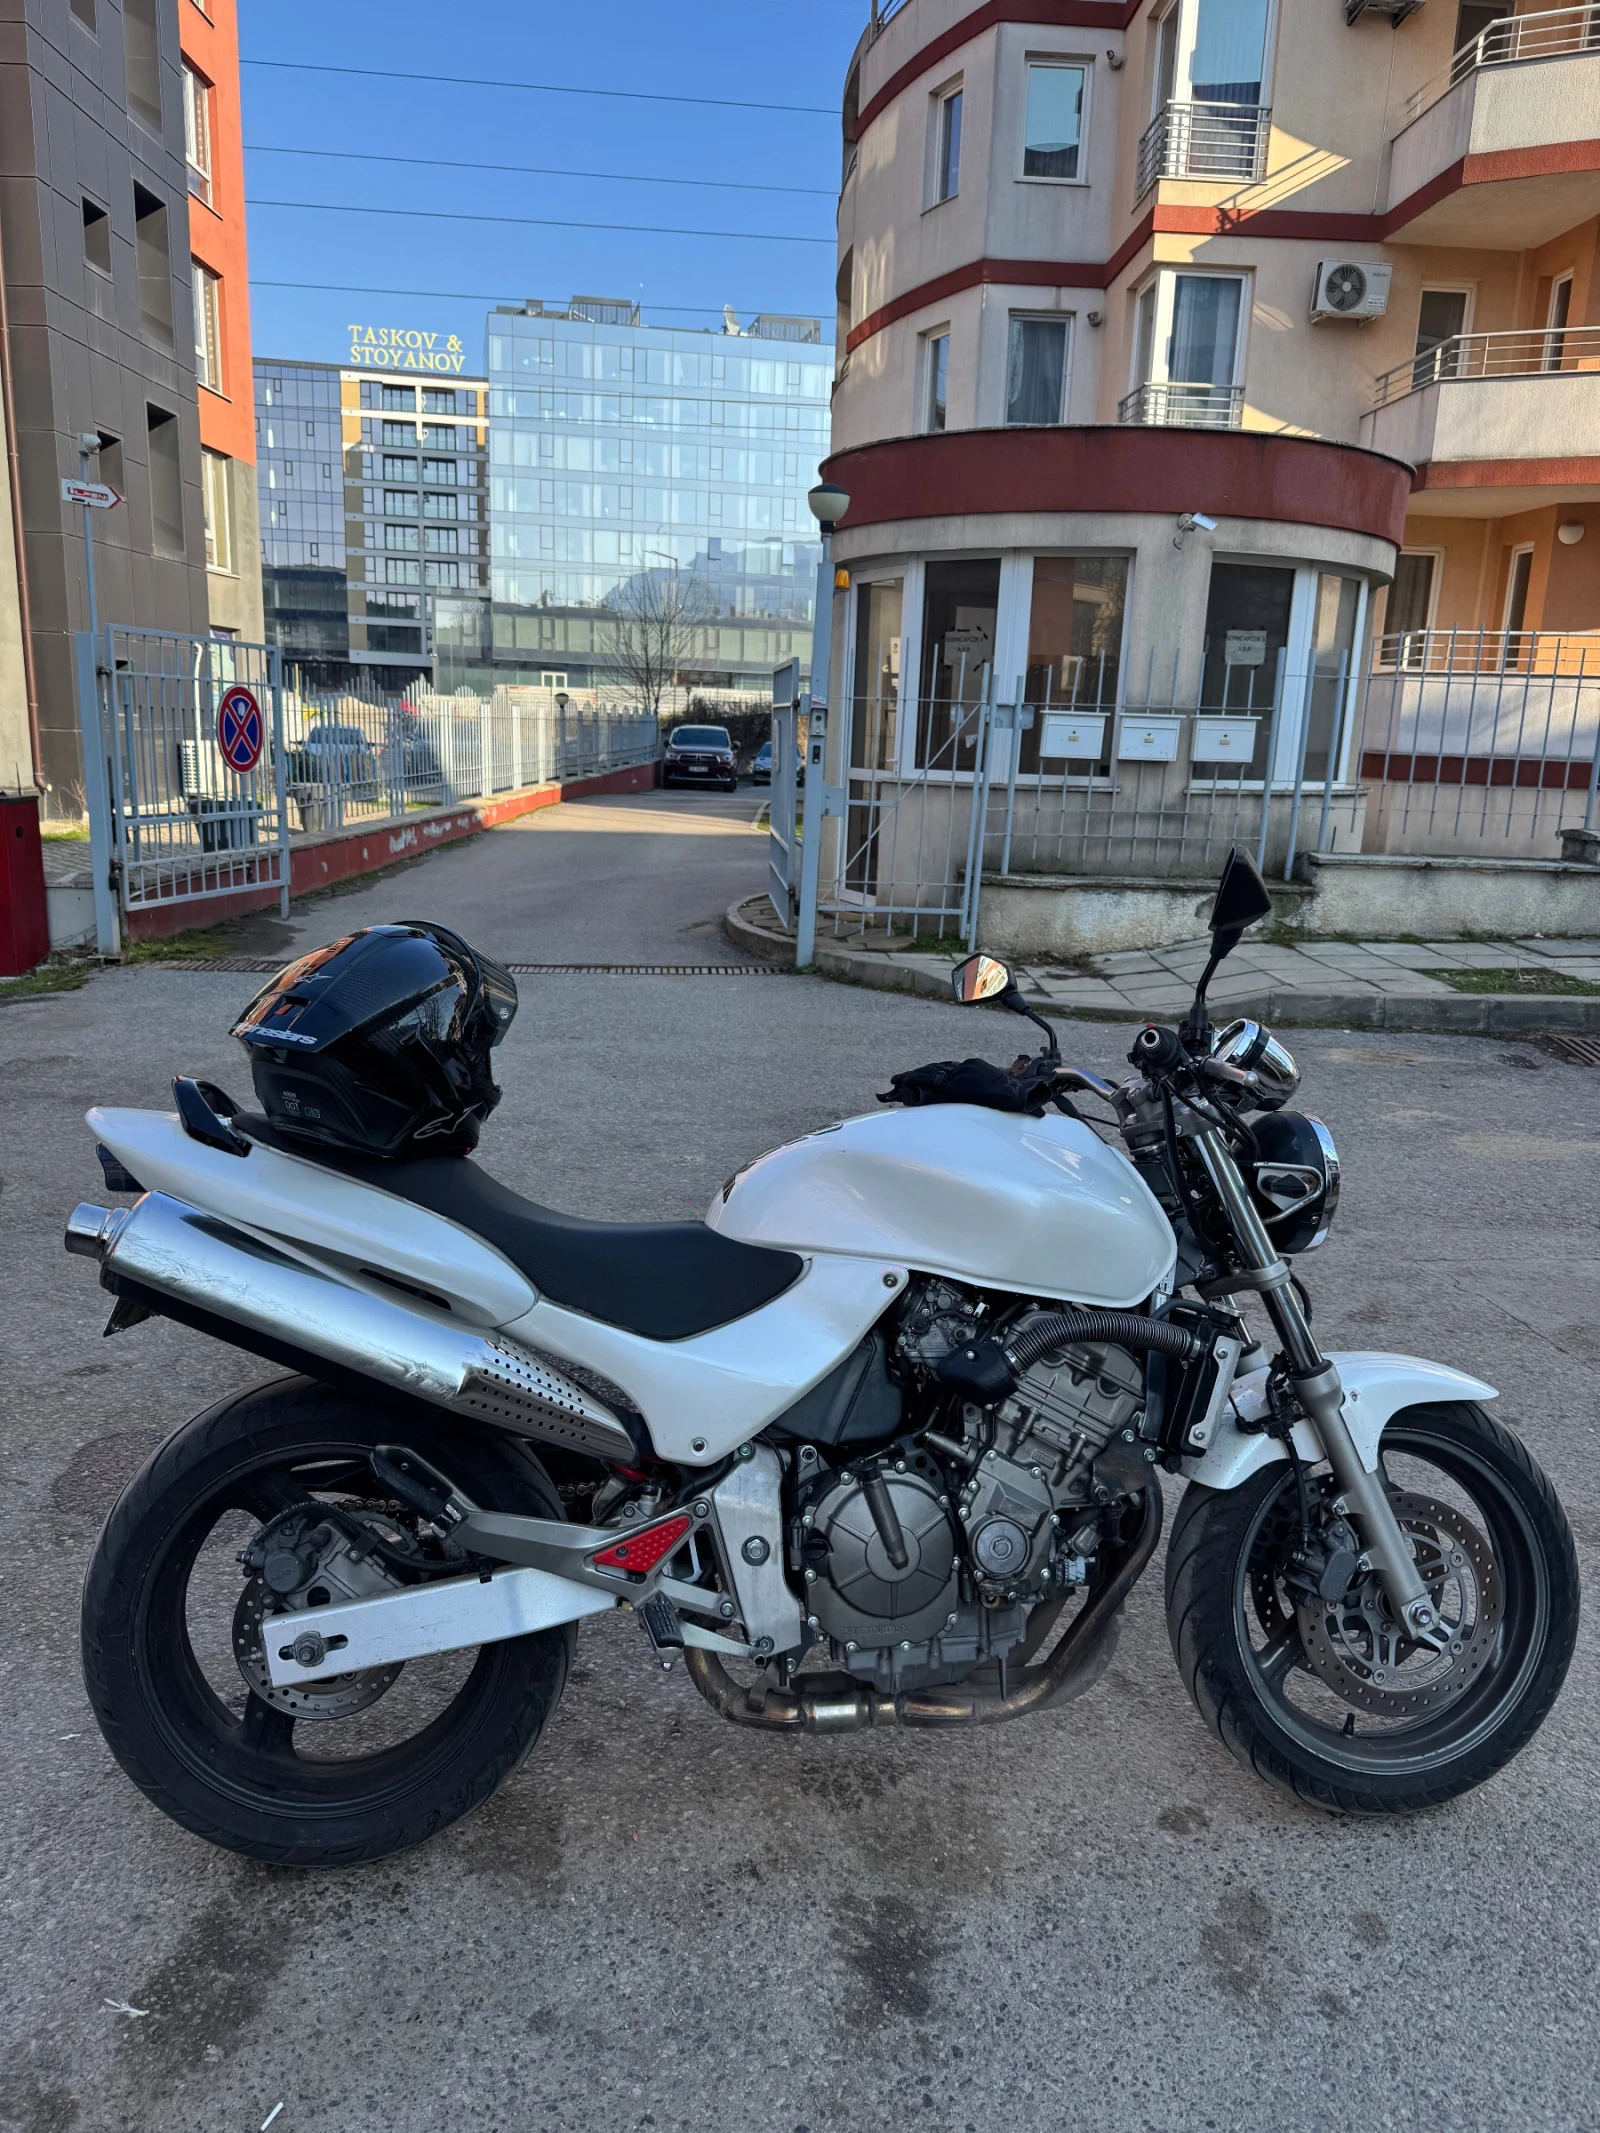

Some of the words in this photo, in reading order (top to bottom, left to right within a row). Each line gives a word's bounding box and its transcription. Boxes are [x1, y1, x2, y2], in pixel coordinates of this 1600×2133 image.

[348, 325, 437, 349] TASKOV
[446, 334, 463, 352] &
[350, 345, 466, 372] STOYANOV
[284, 1100, 300, 1112] DOT
[843, 1624, 909, 1635] HONDA
